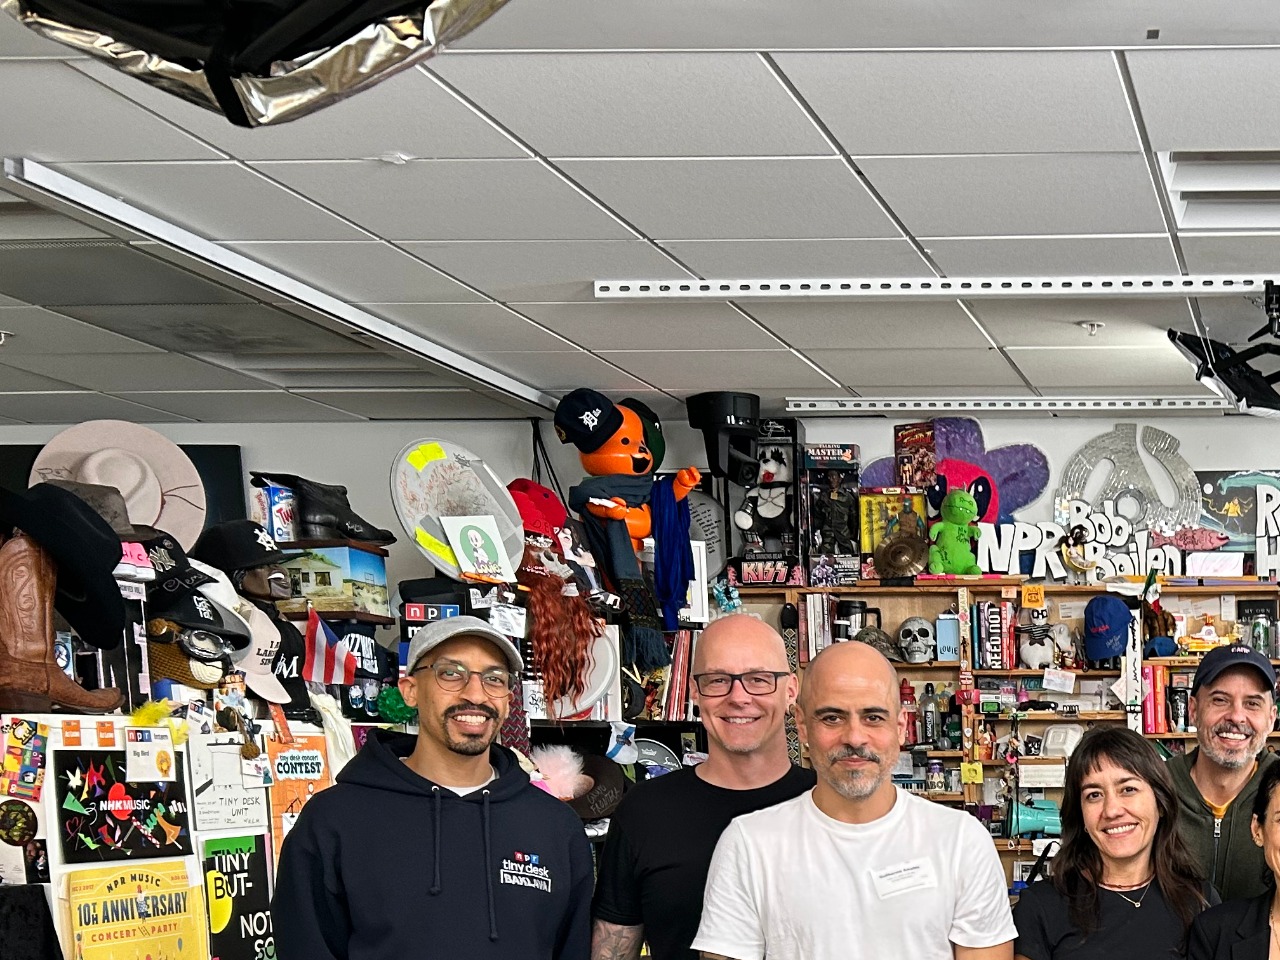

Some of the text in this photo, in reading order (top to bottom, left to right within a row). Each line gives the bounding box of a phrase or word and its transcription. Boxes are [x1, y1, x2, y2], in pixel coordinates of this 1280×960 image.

[807, 448, 841, 457] MASTER
[1069, 499, 1134, 548] Bob
[977, 521, 1068, 580] NPR
[1083, 528, 1182, 586] Boilen
[741, 560, 788, 583] KISS
[410, 605, 455, 619] npr
[939, 646, 959, 655] LOUIE
[128, 730, 152, 742] npr
[277, 761, 322, 775] CONTEST
[219, 796, 260, 807] TINY DESK
[231, 807, 249, 817] UNIT
[211, 845, 252, 874] TINY
[516, 852, 539, 864] npr
[502, 859, 549, 878] tiny desk
[106, 873, 161, 893] NPR MUSIC
[213, 872, 253, 900] BUT-
[101, 891, 188, 924] ANNIVERSARY
[91, 922, 178, 943] CONCERT PARTY
